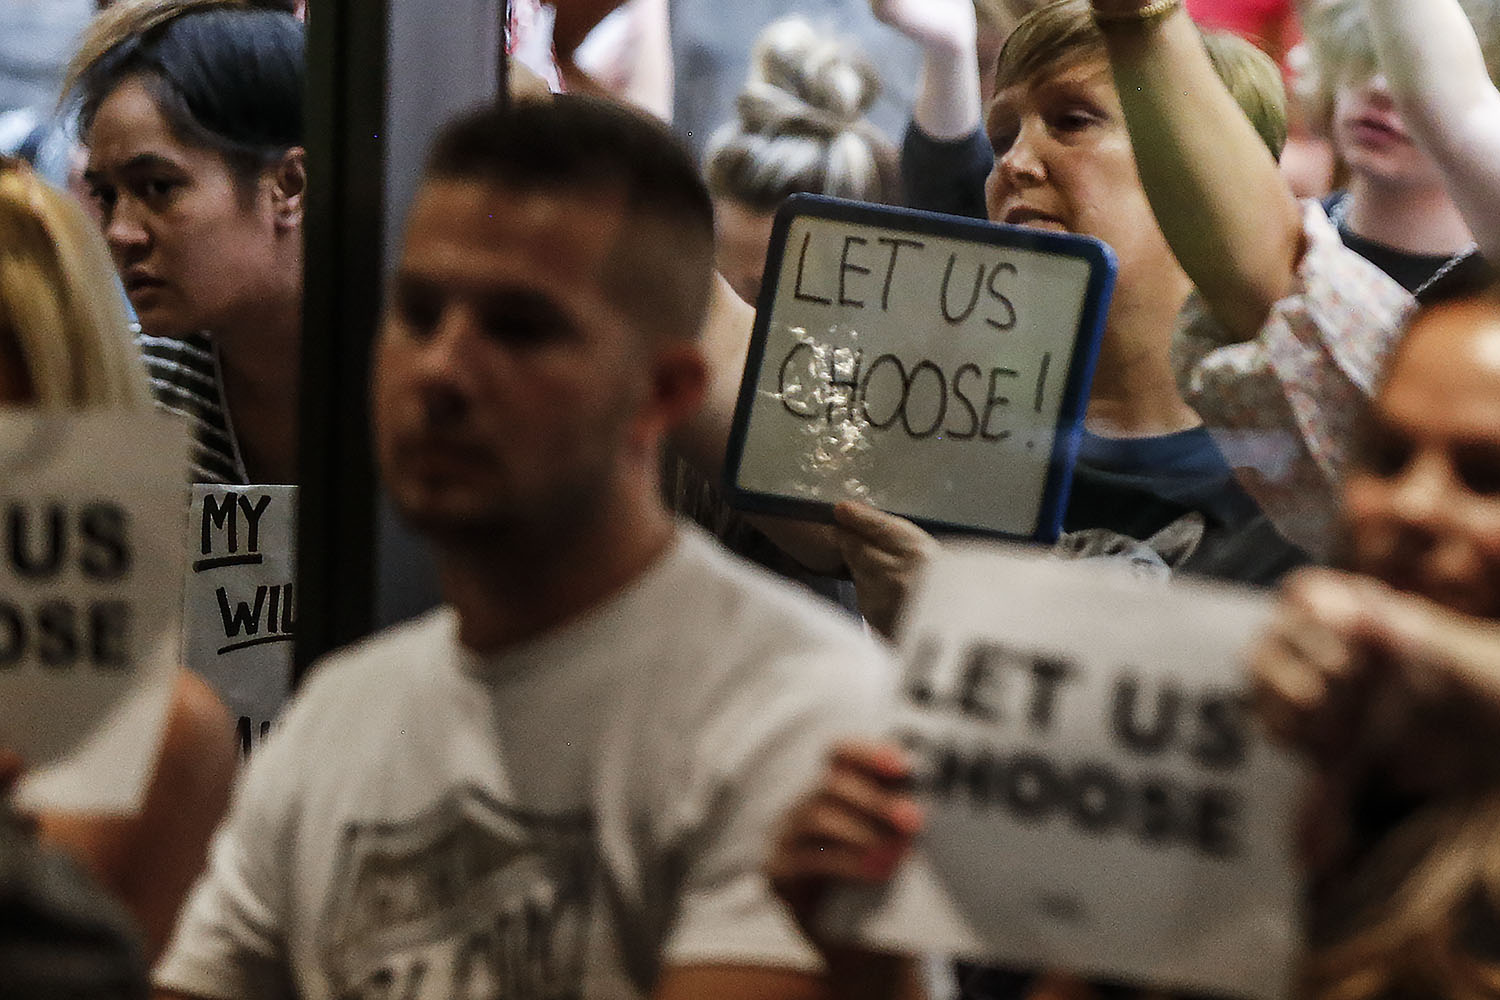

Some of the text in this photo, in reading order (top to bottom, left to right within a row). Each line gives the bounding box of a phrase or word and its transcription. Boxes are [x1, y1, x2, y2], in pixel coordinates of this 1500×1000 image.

[794, 231, 1018, 331] LET US
[779, 341, 1052, 450] CHOOSE!
[8, 500, 131, 584] US
[201, 491, 272, 555] MY
[904, 630, 1246, 768] LET US
